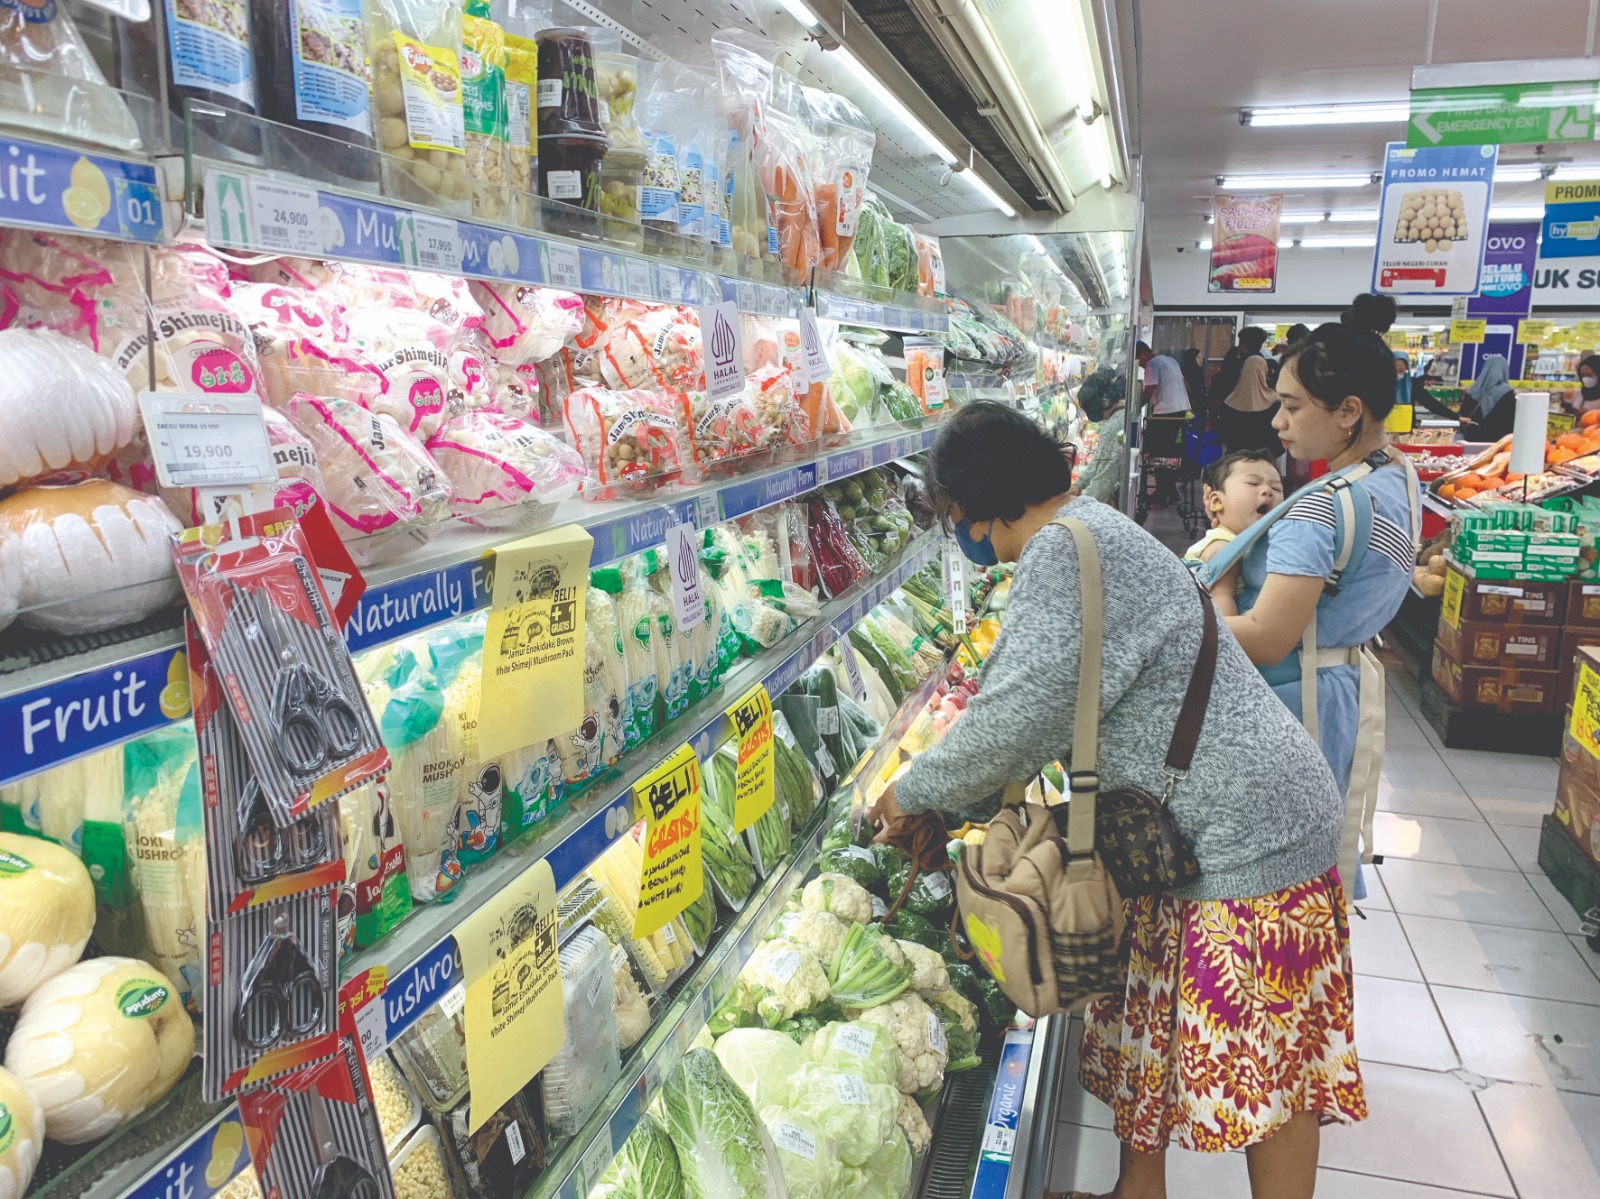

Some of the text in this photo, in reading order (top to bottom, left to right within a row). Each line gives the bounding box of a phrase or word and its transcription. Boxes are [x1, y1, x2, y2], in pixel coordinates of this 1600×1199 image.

[1437, 116, 1542, 134] EMERGENCY EXIT
[1391, 167, 1486, 178] PROMO HEMAT
[127, 199, 156, 225] 01
[274, 209, 309, 227] 24,900
[1220, 206, 1275, 217] SALMON
[1225, 219, 1269, 230] FILLET
[1487, 237, 1526, 249] OVO
[713, 365, 738, 380] HALAL
[183, 444, 233, 460] 19,900
[553, 588, 570, 603] BELI
[345, 571, 464, 639] Naturally
[1517, 636, 1536, 644] TINS
[562, 648, 575, 660] Pack
[22, 670, 146, 755] Fruit
[649, 761, 700, 822] BELI 1
[535, 913, 550, 937] BELI
[548, 968, 559, 986] Pack
[125, 988, 166, 1013] Sunpride
